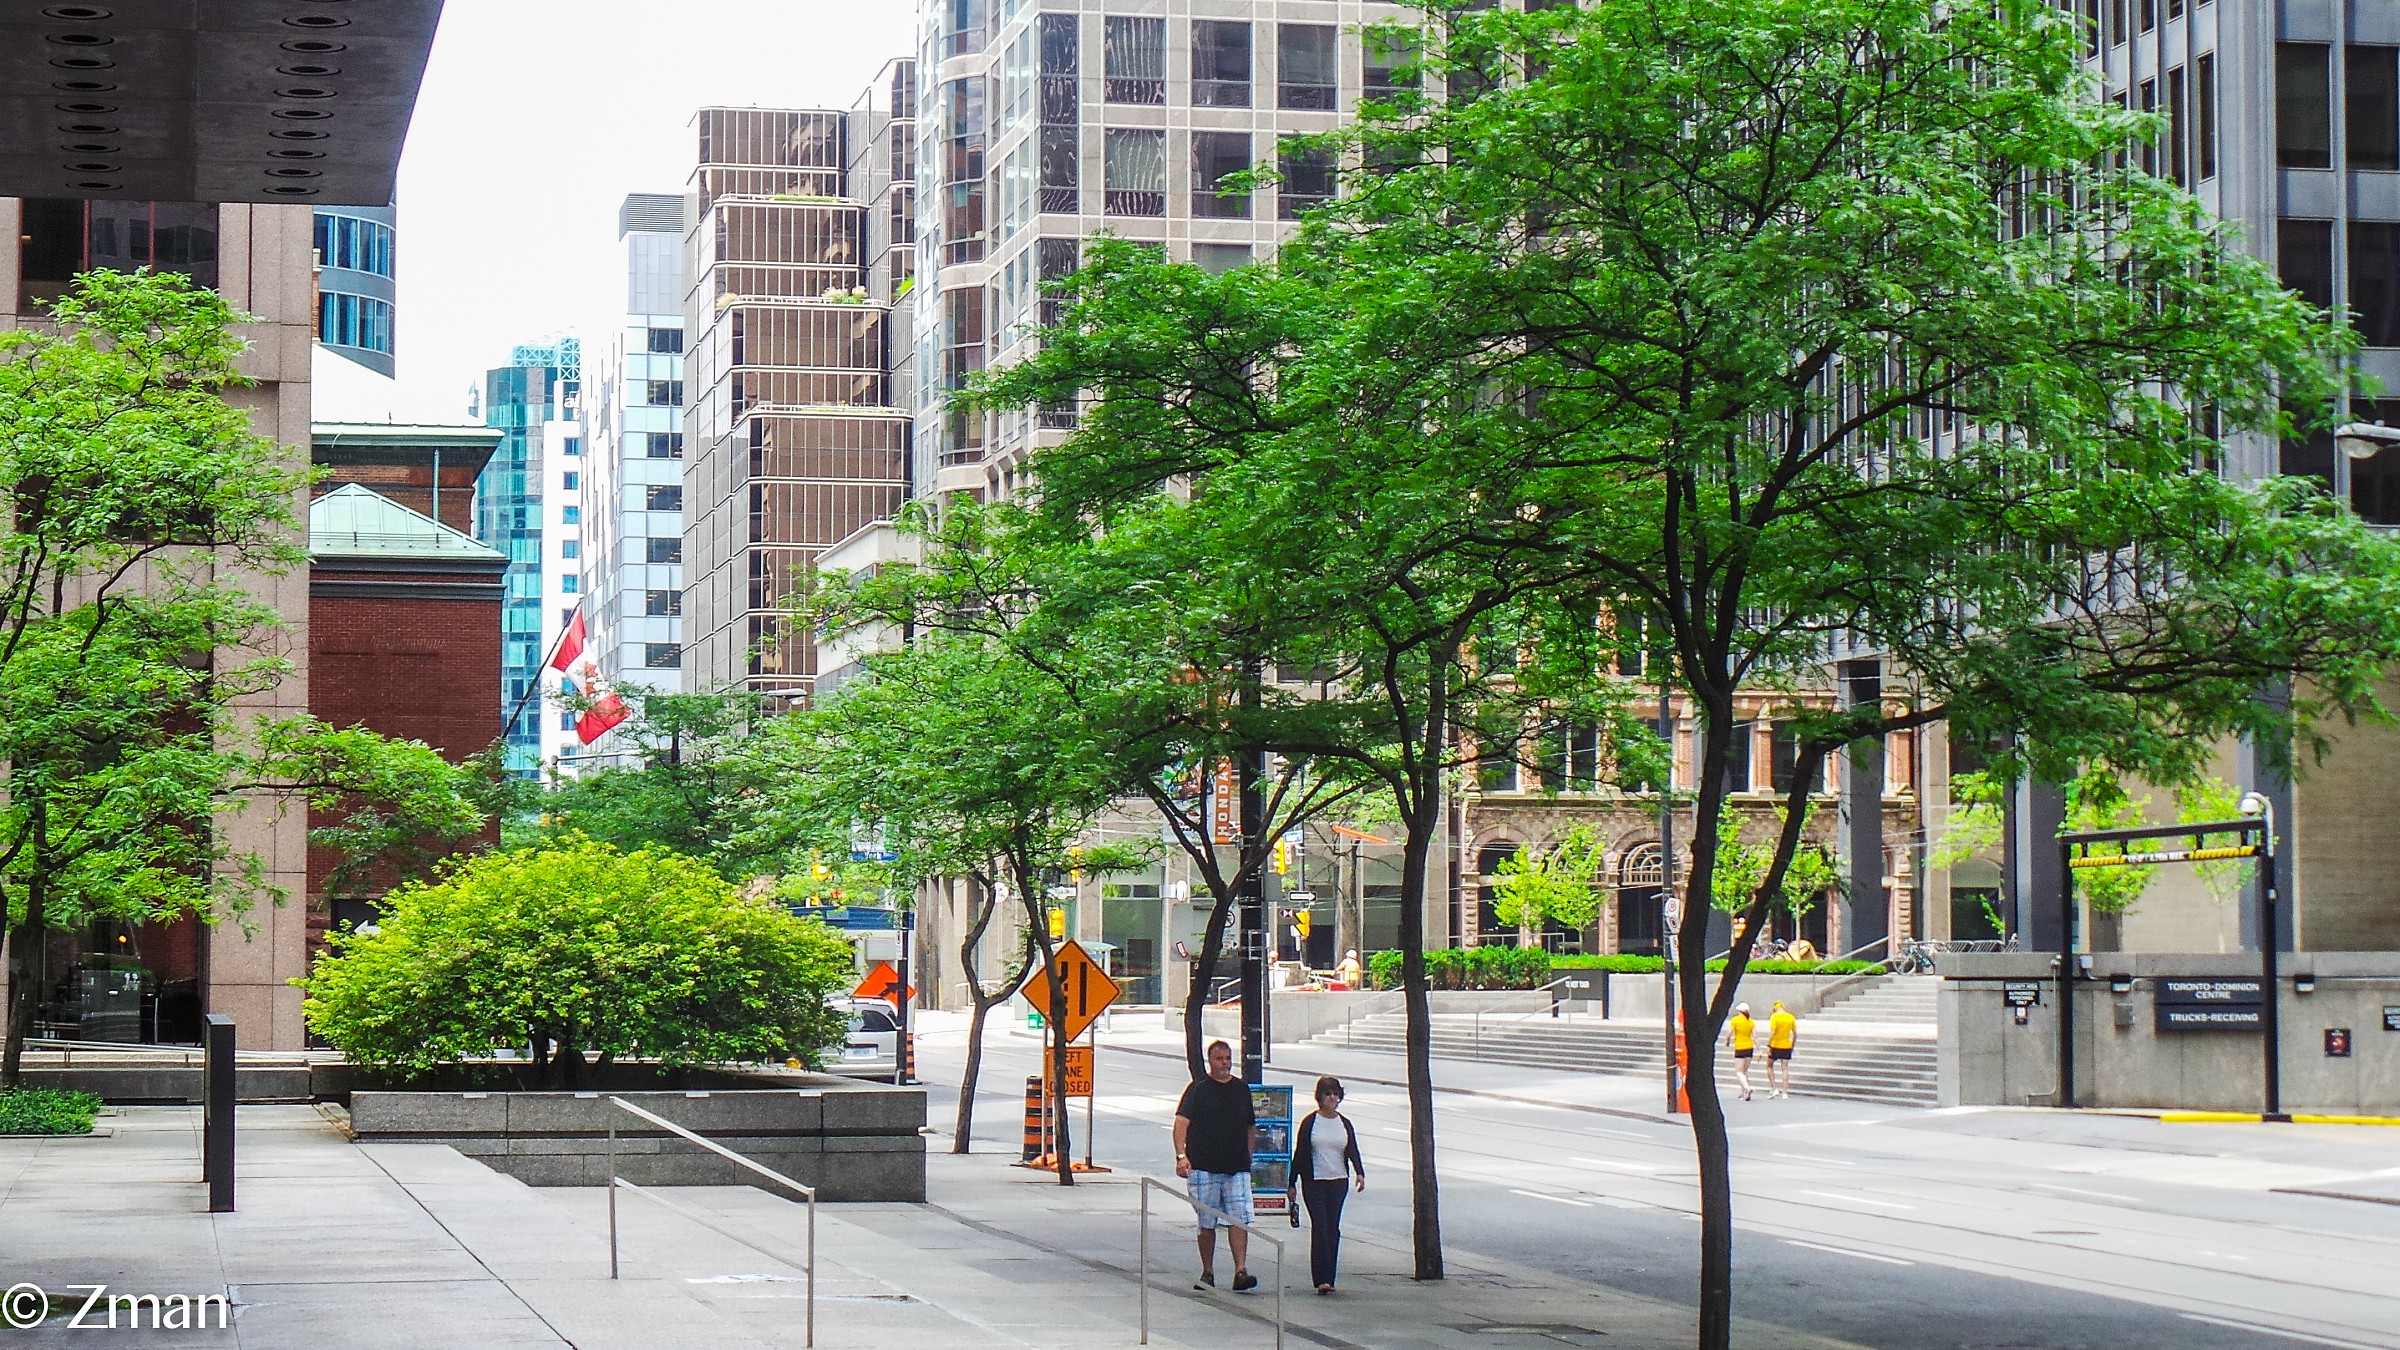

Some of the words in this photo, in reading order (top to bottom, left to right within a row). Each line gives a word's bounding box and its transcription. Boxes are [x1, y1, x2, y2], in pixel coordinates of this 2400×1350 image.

[1217, 771, 1229, 836] HONDA
[2195, 991, 2231, 999] CENTRE
[1065, 1051, 1082, 1063] EFT
[1065, 1066, 1083, 1078] ANE
[1049, 1081, 1091, 1093] COSED
